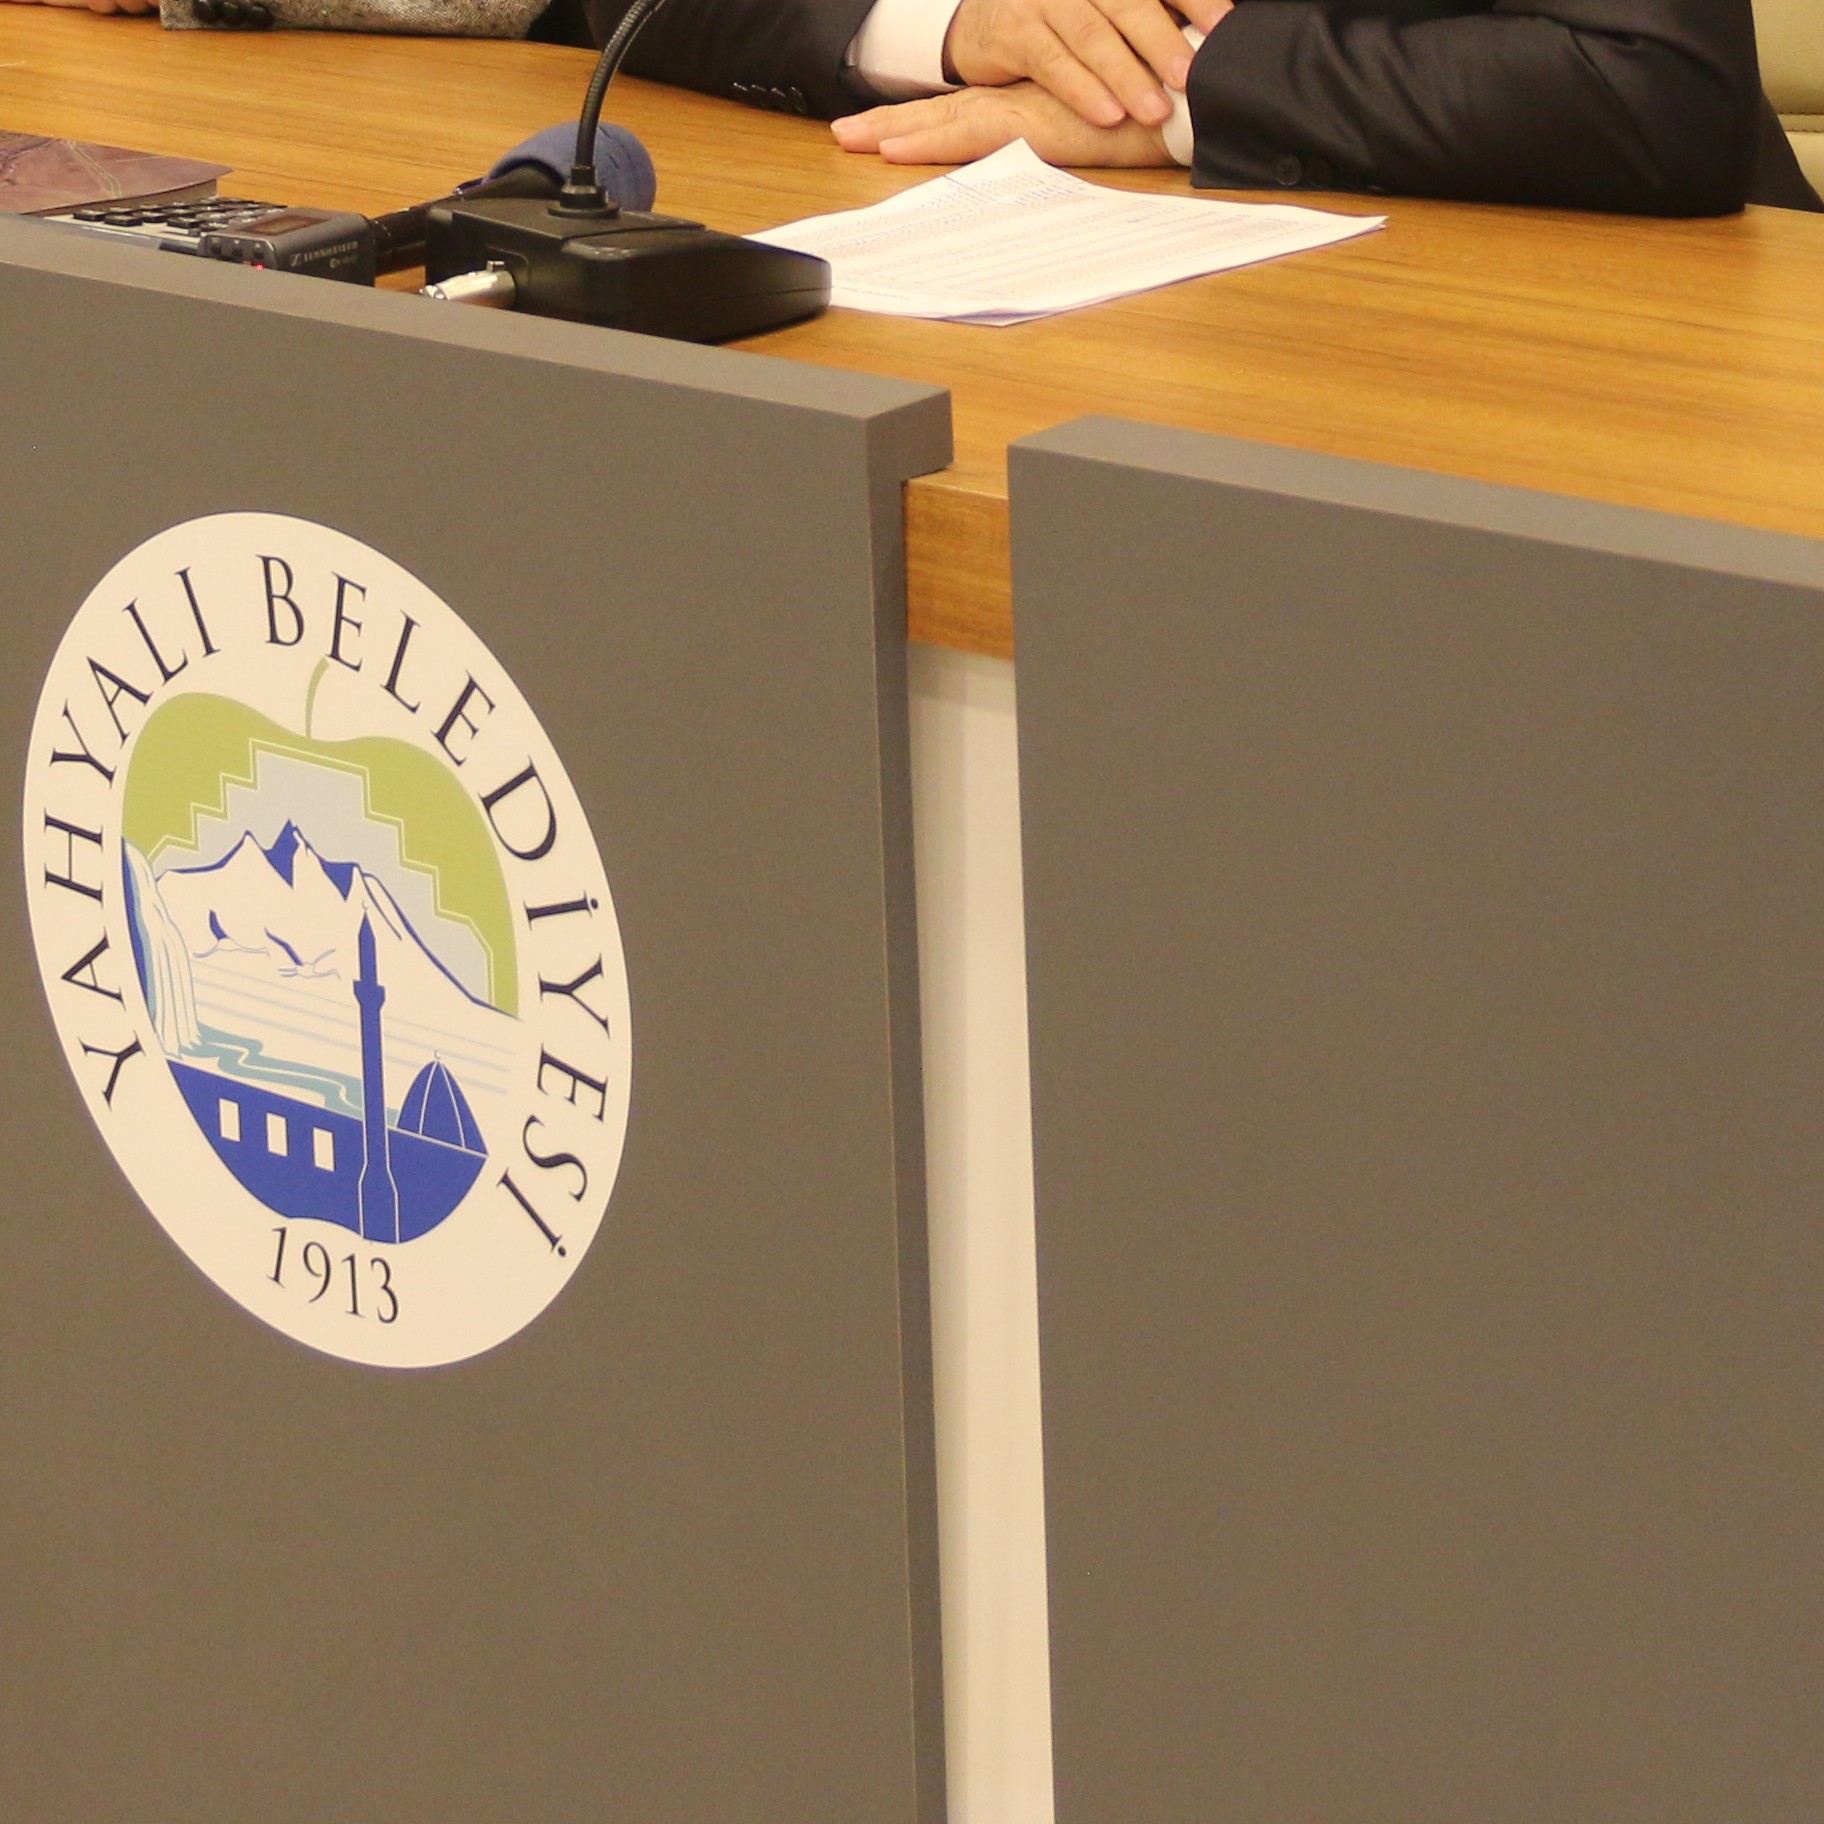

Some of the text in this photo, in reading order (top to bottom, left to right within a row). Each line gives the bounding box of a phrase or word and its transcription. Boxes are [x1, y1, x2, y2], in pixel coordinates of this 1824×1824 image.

[44, 553, 609, 1259] YAHYALI BELEDİYESİ
[266, 1224, 400, 1324] 1913
